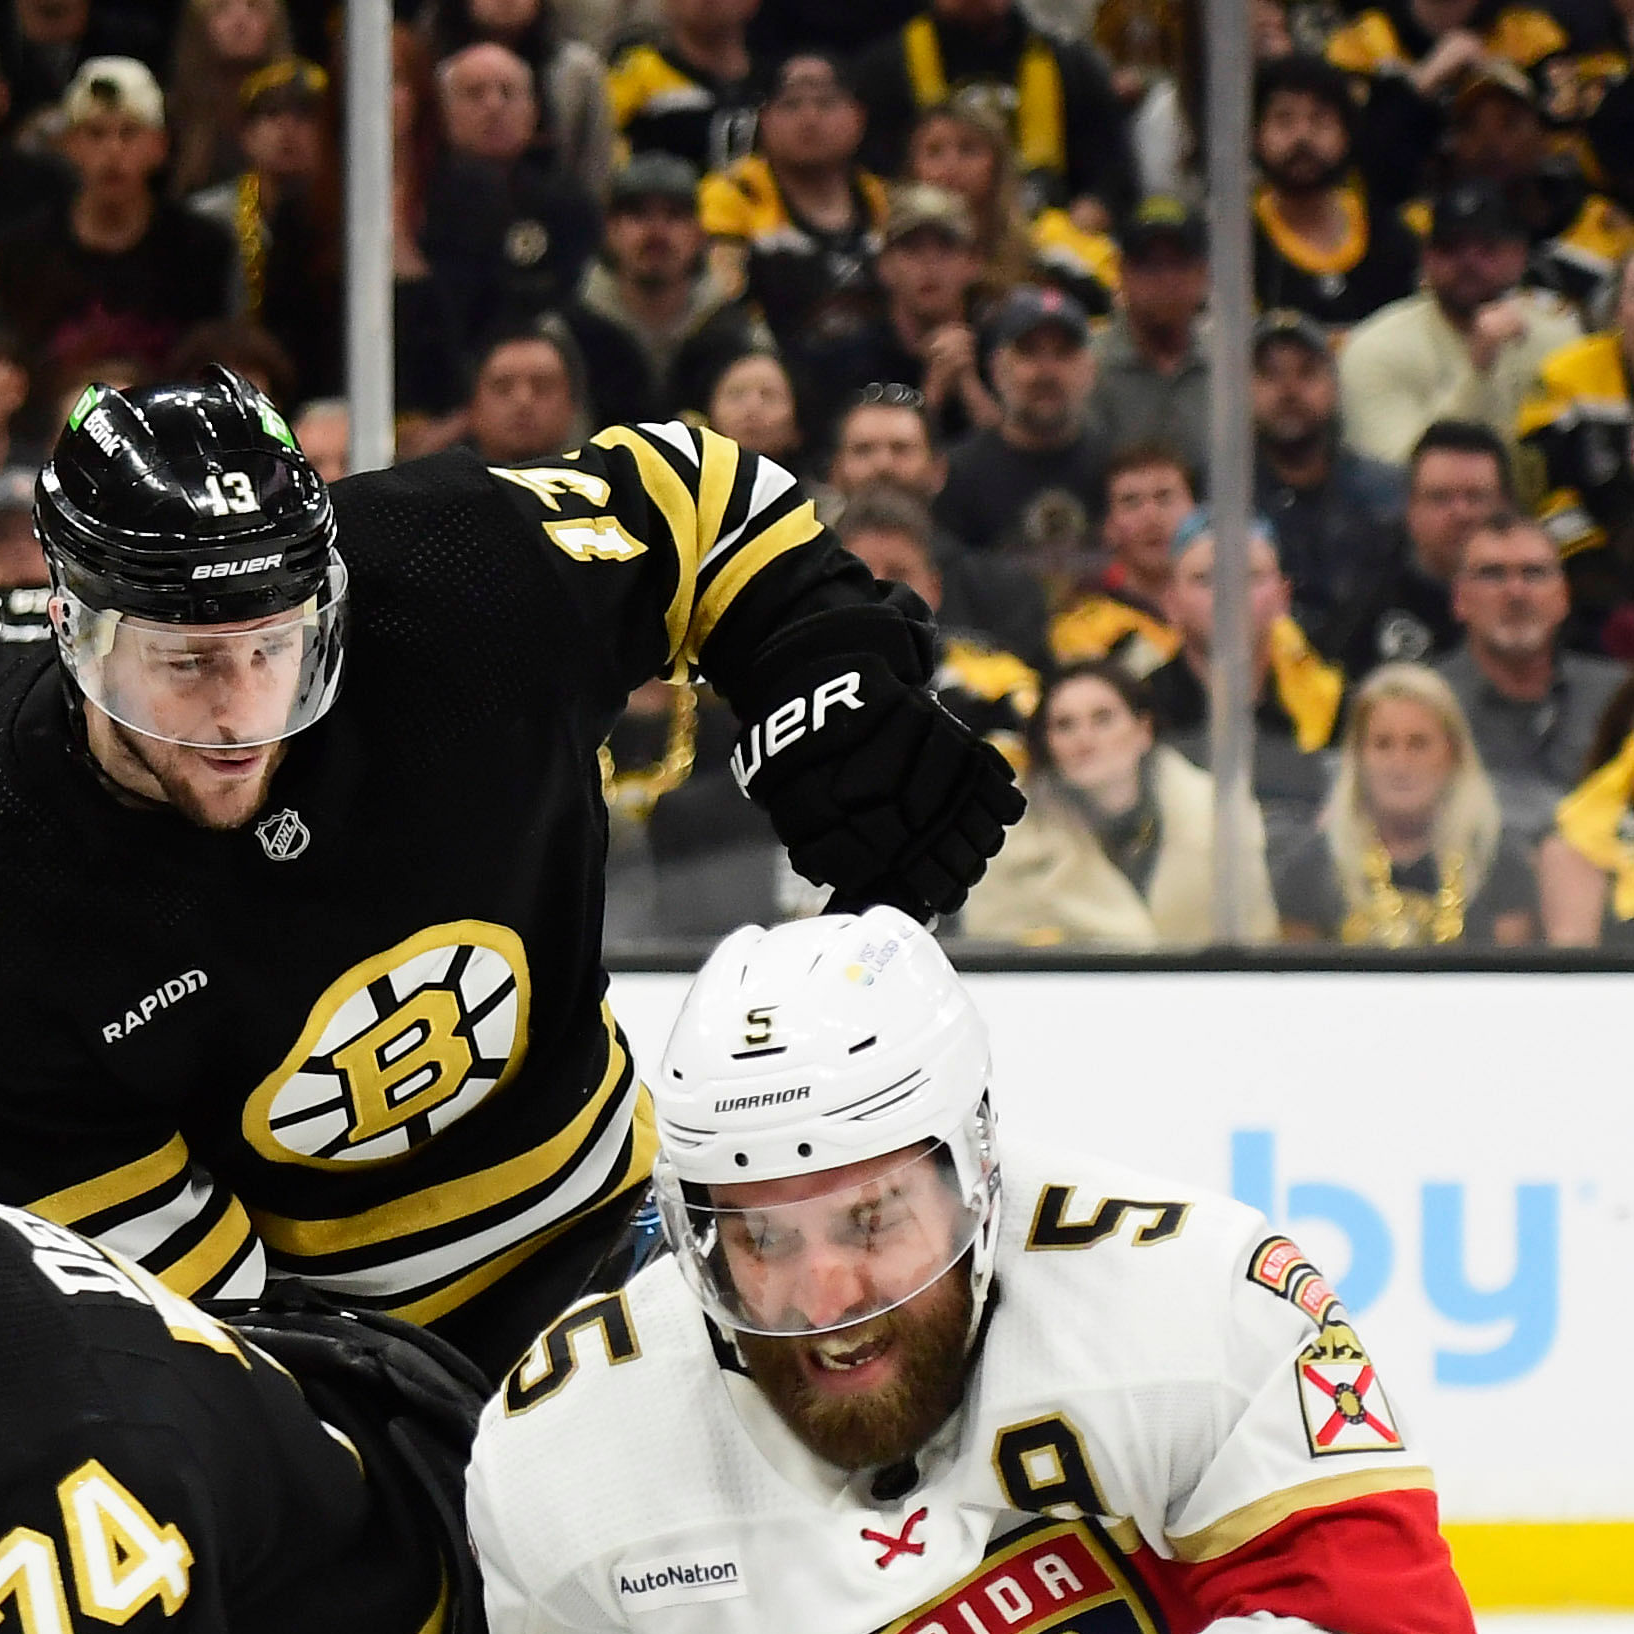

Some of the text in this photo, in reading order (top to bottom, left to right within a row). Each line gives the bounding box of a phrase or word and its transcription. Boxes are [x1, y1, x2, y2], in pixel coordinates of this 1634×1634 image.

[205, 472, 261, 516] 13
[192, 553, 283, 580] BAUER
[730, 671, 866, 799] UER
[102, 969, 208, 1043] RAPID7
[332, 989, 473, 1143] B
[714, 1086, 811, 1113] WARRIOR
[1025, 1183, 1195, 1252] 5
[503, 1288, 643, 1419] 5
[620, 1562, 737, 1595] AutoNation
